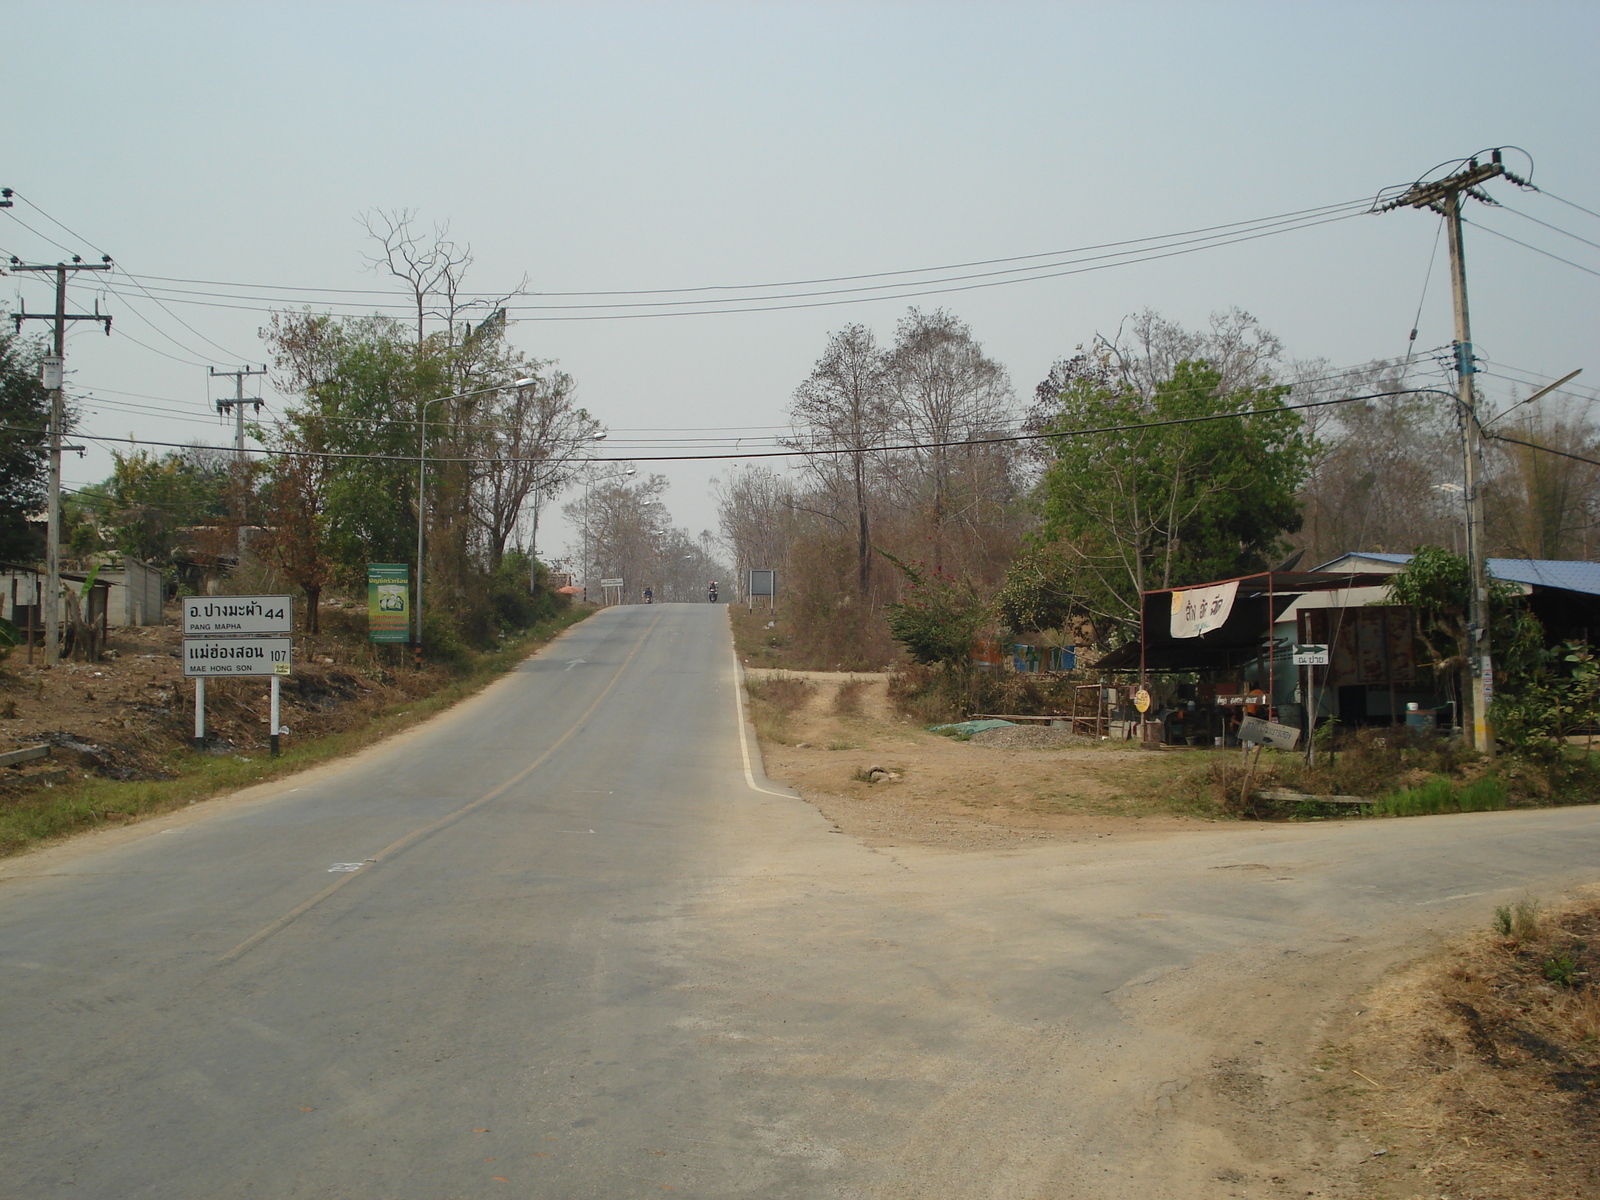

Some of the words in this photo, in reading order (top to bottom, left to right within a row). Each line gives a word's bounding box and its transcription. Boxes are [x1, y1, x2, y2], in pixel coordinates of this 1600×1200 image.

[265, 609, 284, 619] 44
[190, 643, 264, 659] แม่ฮ่องสอน
[271, 651, 286, 661] 107
[1298, 656, 1307, 664] ณ
[1308, 655, 1324, 664] ปาย
